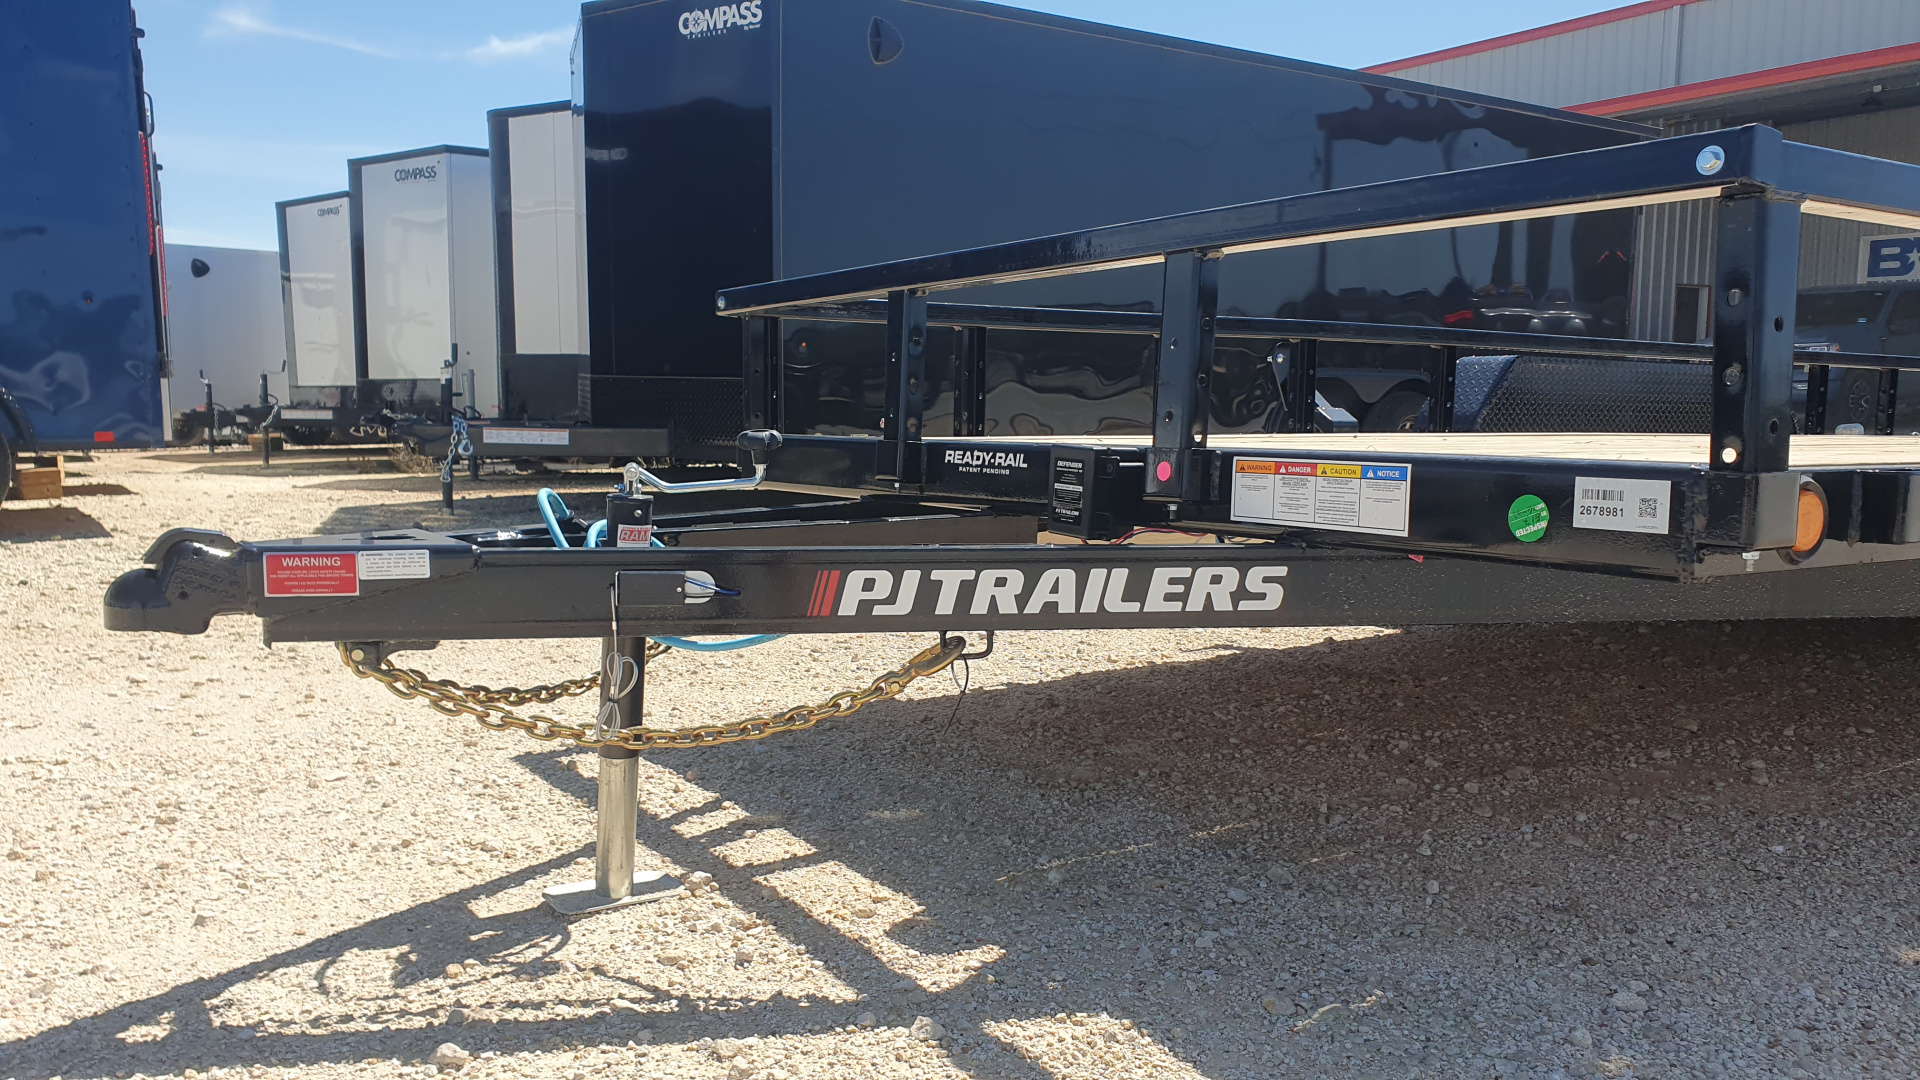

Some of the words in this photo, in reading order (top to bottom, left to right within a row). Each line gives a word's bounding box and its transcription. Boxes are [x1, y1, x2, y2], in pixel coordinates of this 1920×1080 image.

[678, 0, 763, 35] COMPASS
[394, 166, 437, 182] COMPASS
[317, 206, 340, 217] COMPASS
[958, 466, 981, 474] PATENT
[982, 467, 1010, 475] PENDING
[1246, 464, 1272, 472] WARNING
[1287, 465, 1312, 474] DANGER
[1330, 467, 1357, 476] CAUTION
[1376, 469, 1400, 478] NOTICE
[1579, 504, 1625, 518] 2678981
[1515, 519, 1548, 537] INSPECTED
[620, 530, 650, 541] RAM
[281, 556, 341, 567] WARNING
[837, 569, 922, 616] PJ
[929, 565, 1288, 616] TRAILERS
